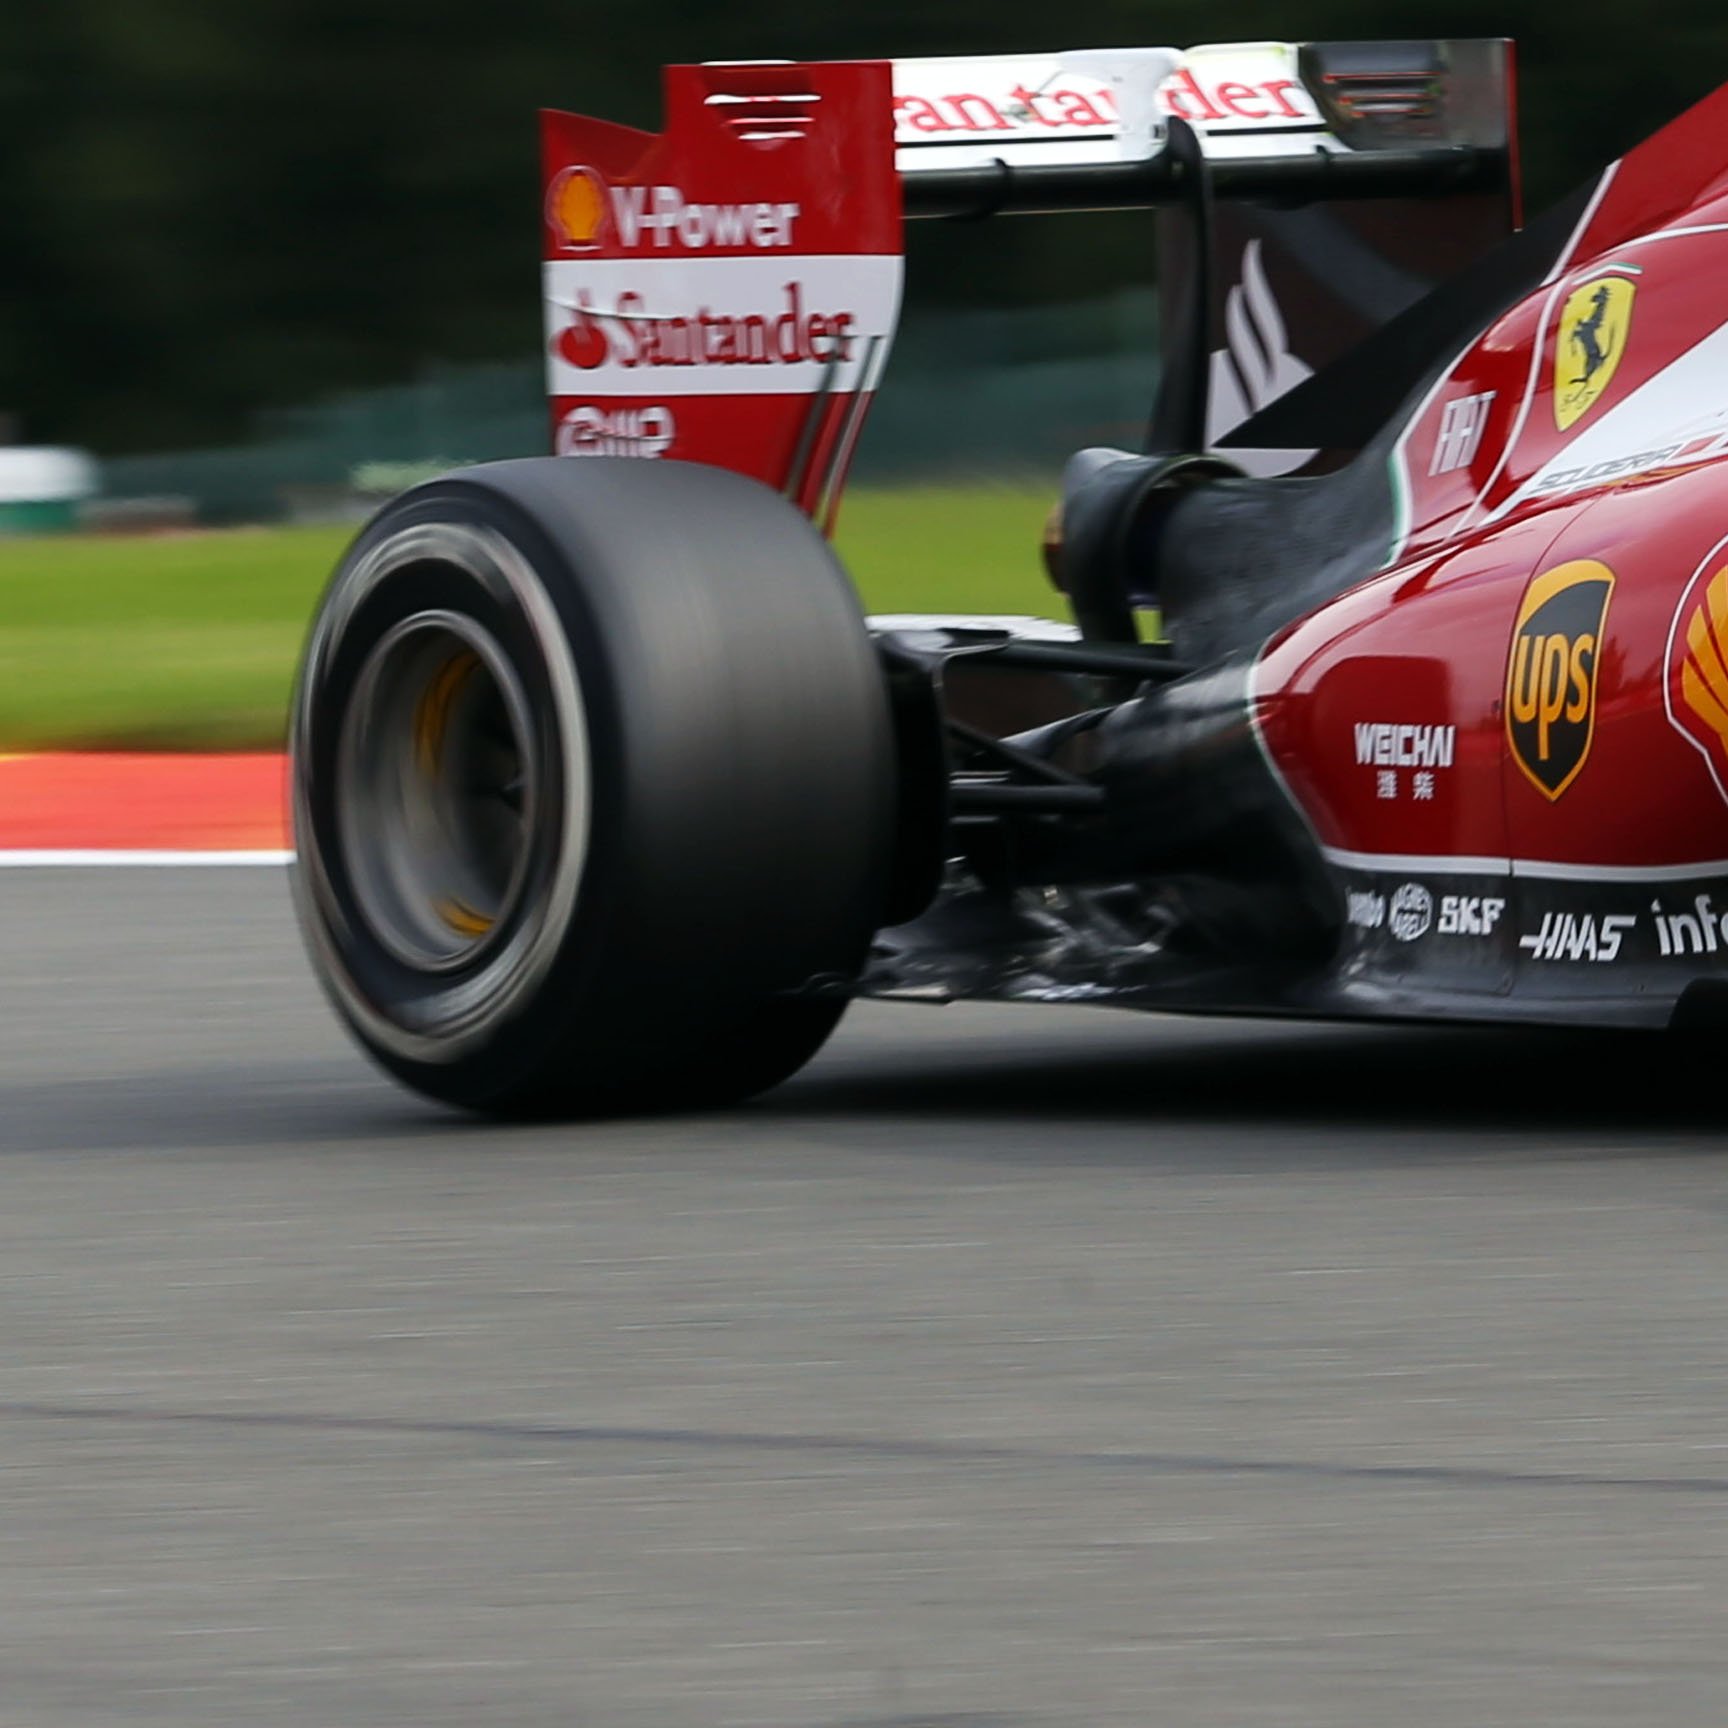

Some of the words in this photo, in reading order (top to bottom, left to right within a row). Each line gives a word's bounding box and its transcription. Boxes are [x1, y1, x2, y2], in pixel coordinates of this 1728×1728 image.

[893, 68, 1307, 132] antader
[608, 185, 799, 248] V-Power
[616, 281, 855, 367] Santander
[1513, 632, 1596, 761] ups
[1354, 722, 1456, 767] WEICHAI
[1437, 895, 1506, 935] SKF
